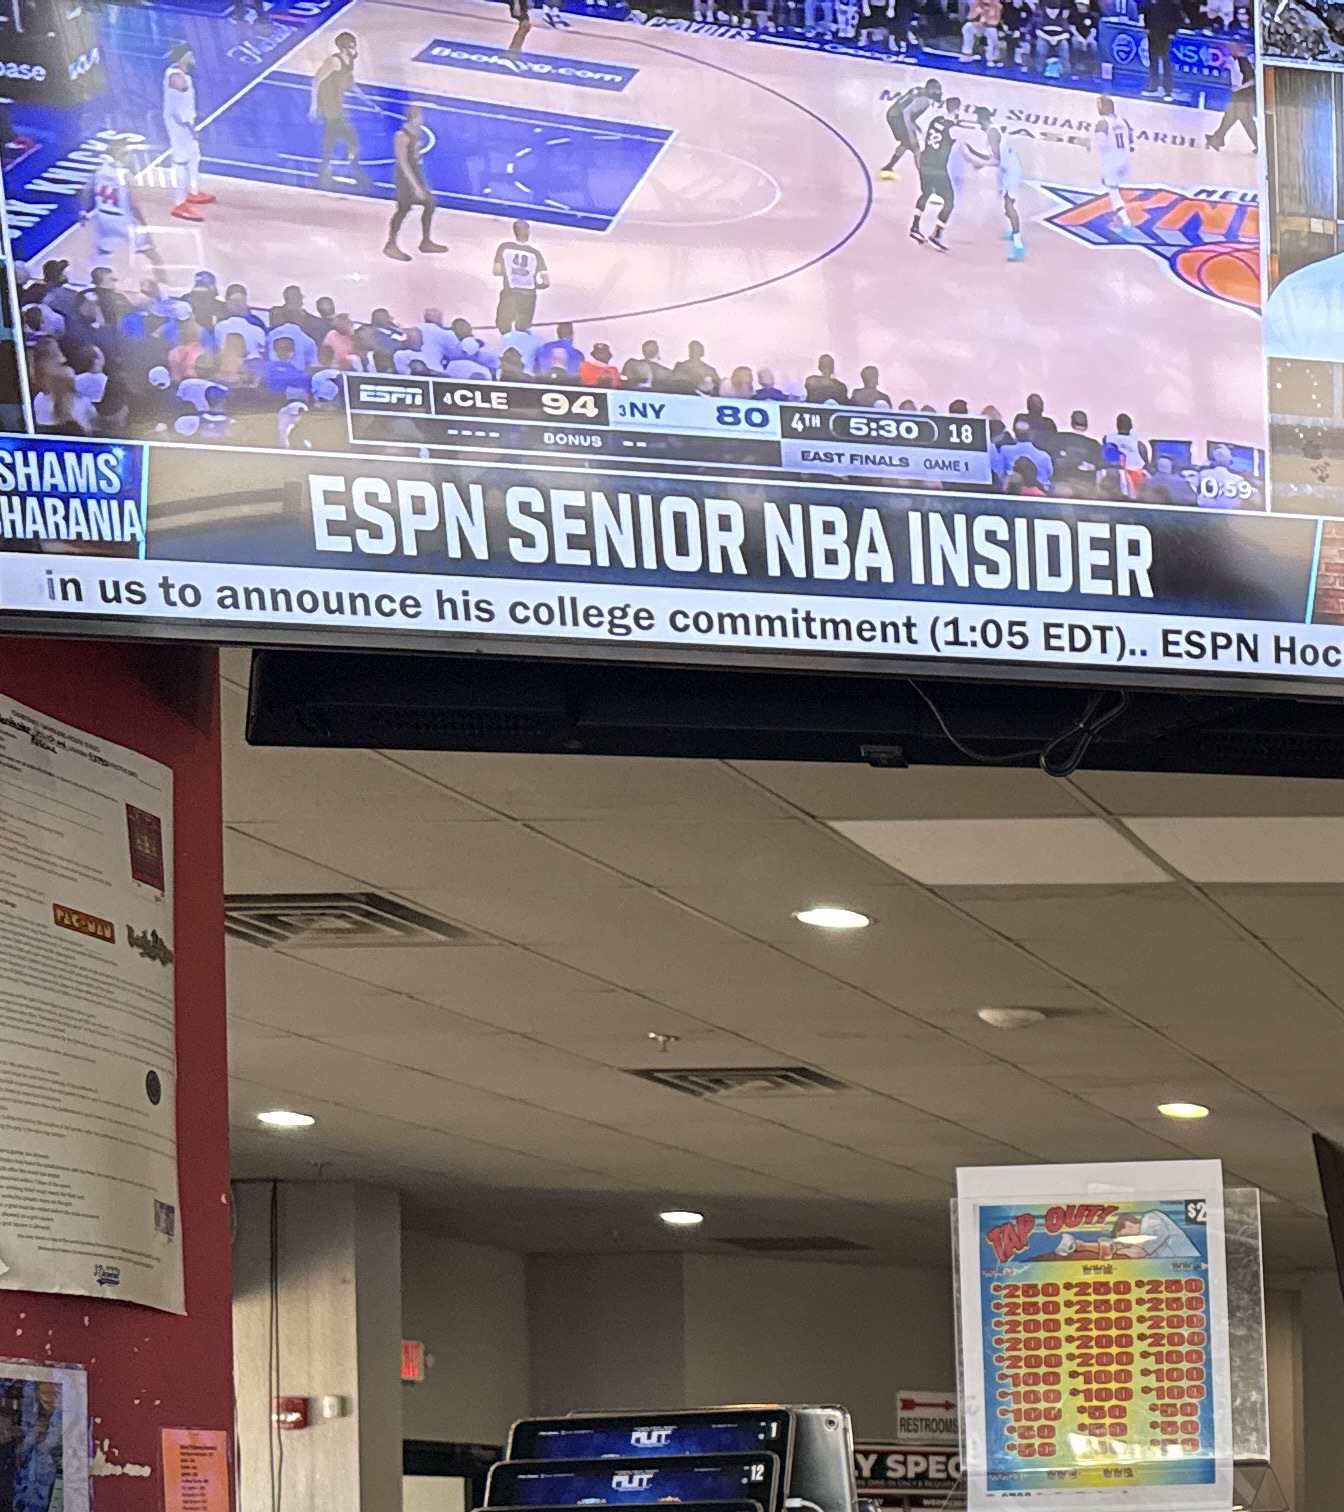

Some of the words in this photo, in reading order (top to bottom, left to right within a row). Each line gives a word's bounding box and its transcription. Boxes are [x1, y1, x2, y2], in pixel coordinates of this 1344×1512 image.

[359, 384, 423, 405] ESPN
[453, 390, 508, 410] CLE
[541, 392, 599, 418] 94
[628, 403, 667, 421] NY
[716, 404, 769, 429] 80
[542, 432, 602, 448] BONUS
[848, 417, 920, 439] 5:30
[948, 421, 974, 444] 18
[0, 451, 121, 495] SHAMS
[800, 450, 843, 468] EAST
[848, 452, 910, 471] FINALS
[923, 457, 961, 471] GAME
[1200, 476, 1254, 501] 0:59
[0, 494, 145, 544] HARANIA
[309, 474, 490, 560] ESPN
[508, 485, 748, 577] SENIOR
[764, 503, 895, 584] NBA
[908, 510, 1154, 599] INSIDER
[100, 580, 146, 606] us
[159, 577, 202, 609] to
[216, 584, 422, 620] announce
[436, 589, 495, 623] his
[509, 597, 655, 637] college
[669, 603, 918, 646] commitment
[929, 611, 1029, 652] (1:05
[1042, 622, 1148, 660] EDT)..
[1161, 631, 1258, 664] ESPN
[1187, 1203, 1207, 1219] $2
[986, 1213, 1034, 1263] TAP
[900, 1418, 958, 1433] RESTROOMS
[749, 1465, 765, 1480] 12
